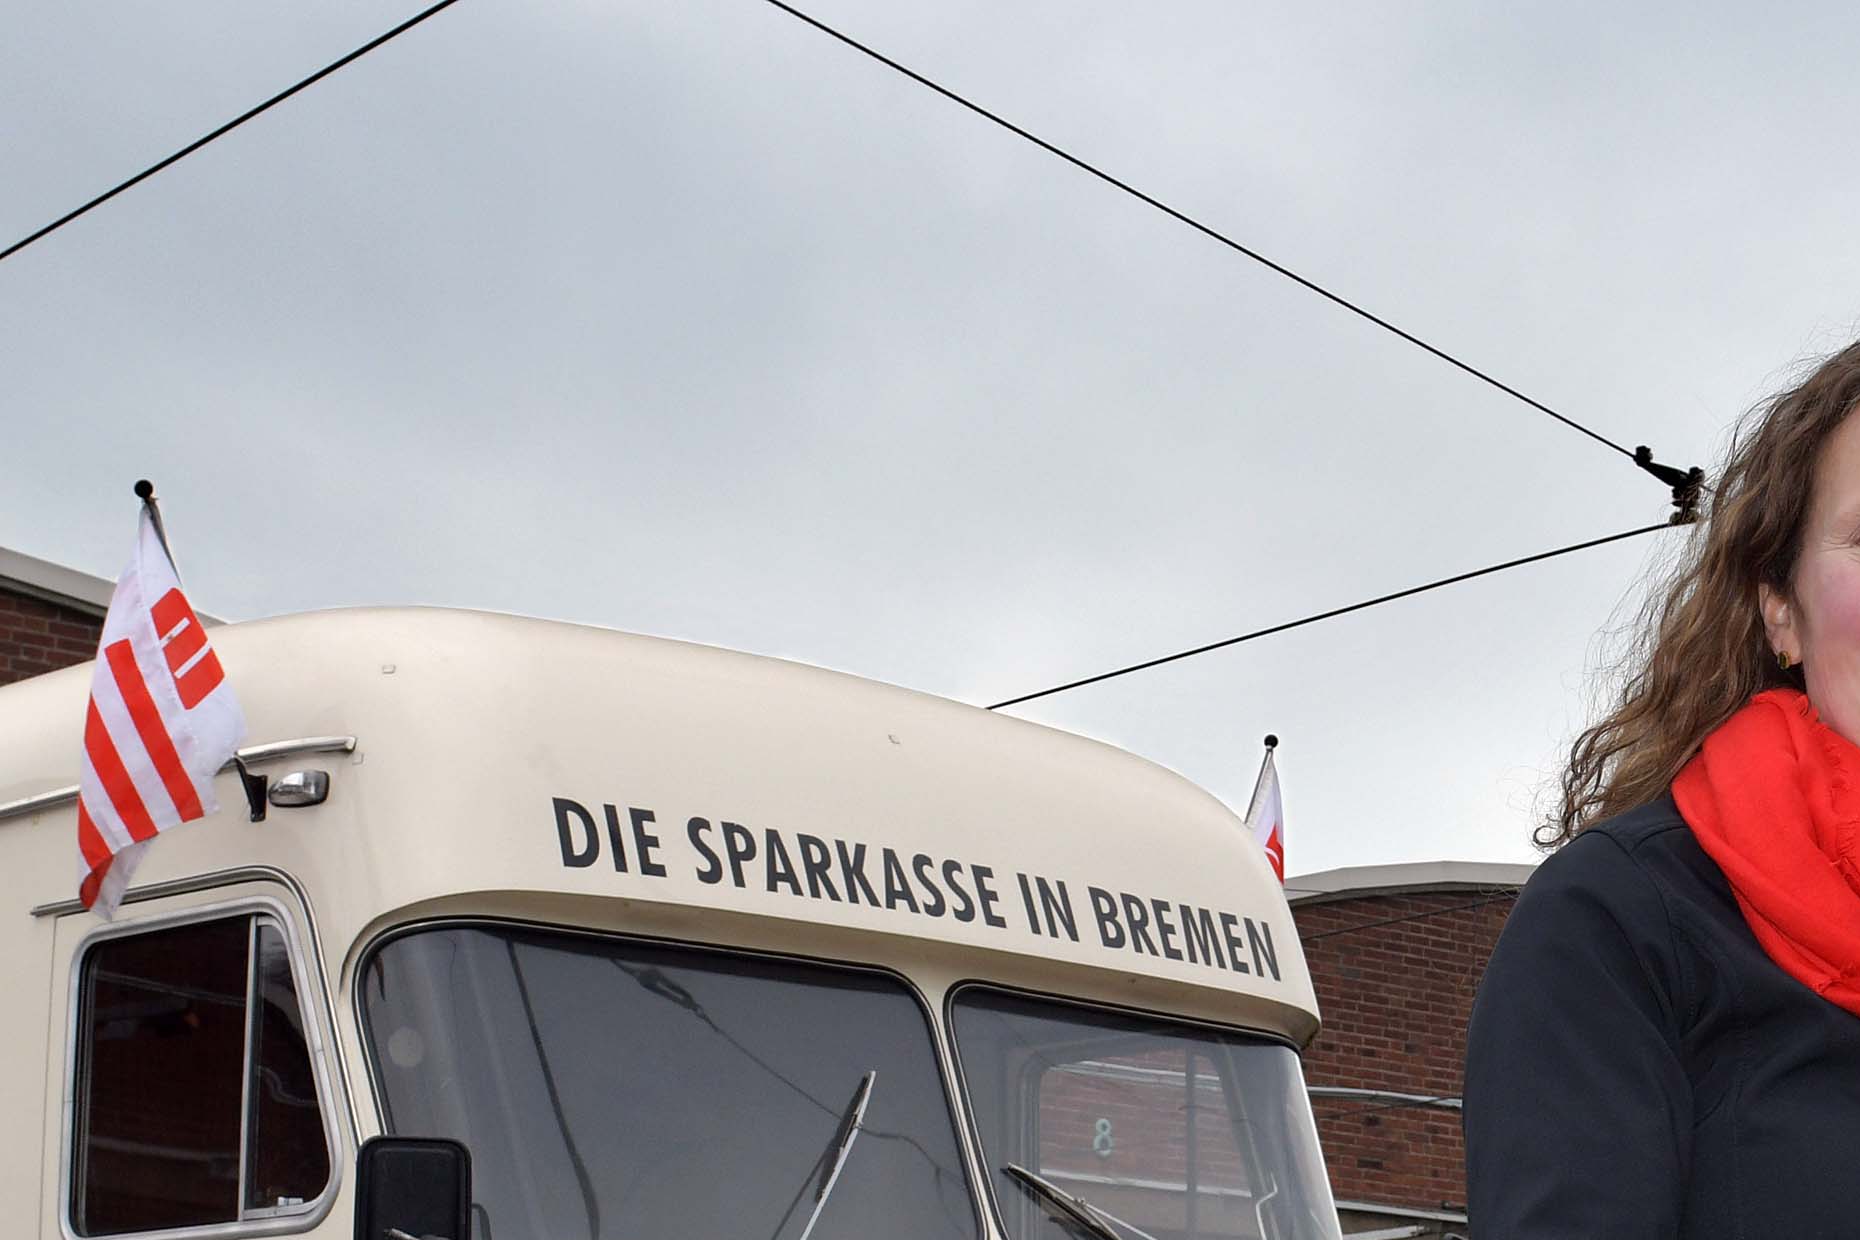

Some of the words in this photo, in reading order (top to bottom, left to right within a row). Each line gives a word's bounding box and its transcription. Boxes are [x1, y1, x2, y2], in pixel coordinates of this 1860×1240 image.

[552, 797, 667, 877] DIE
[686, 816, 1007, 928] SPARKASSE
[1016, 872, 1080, 943] IN
[1087, 885, 1281, 982] BREMEN
